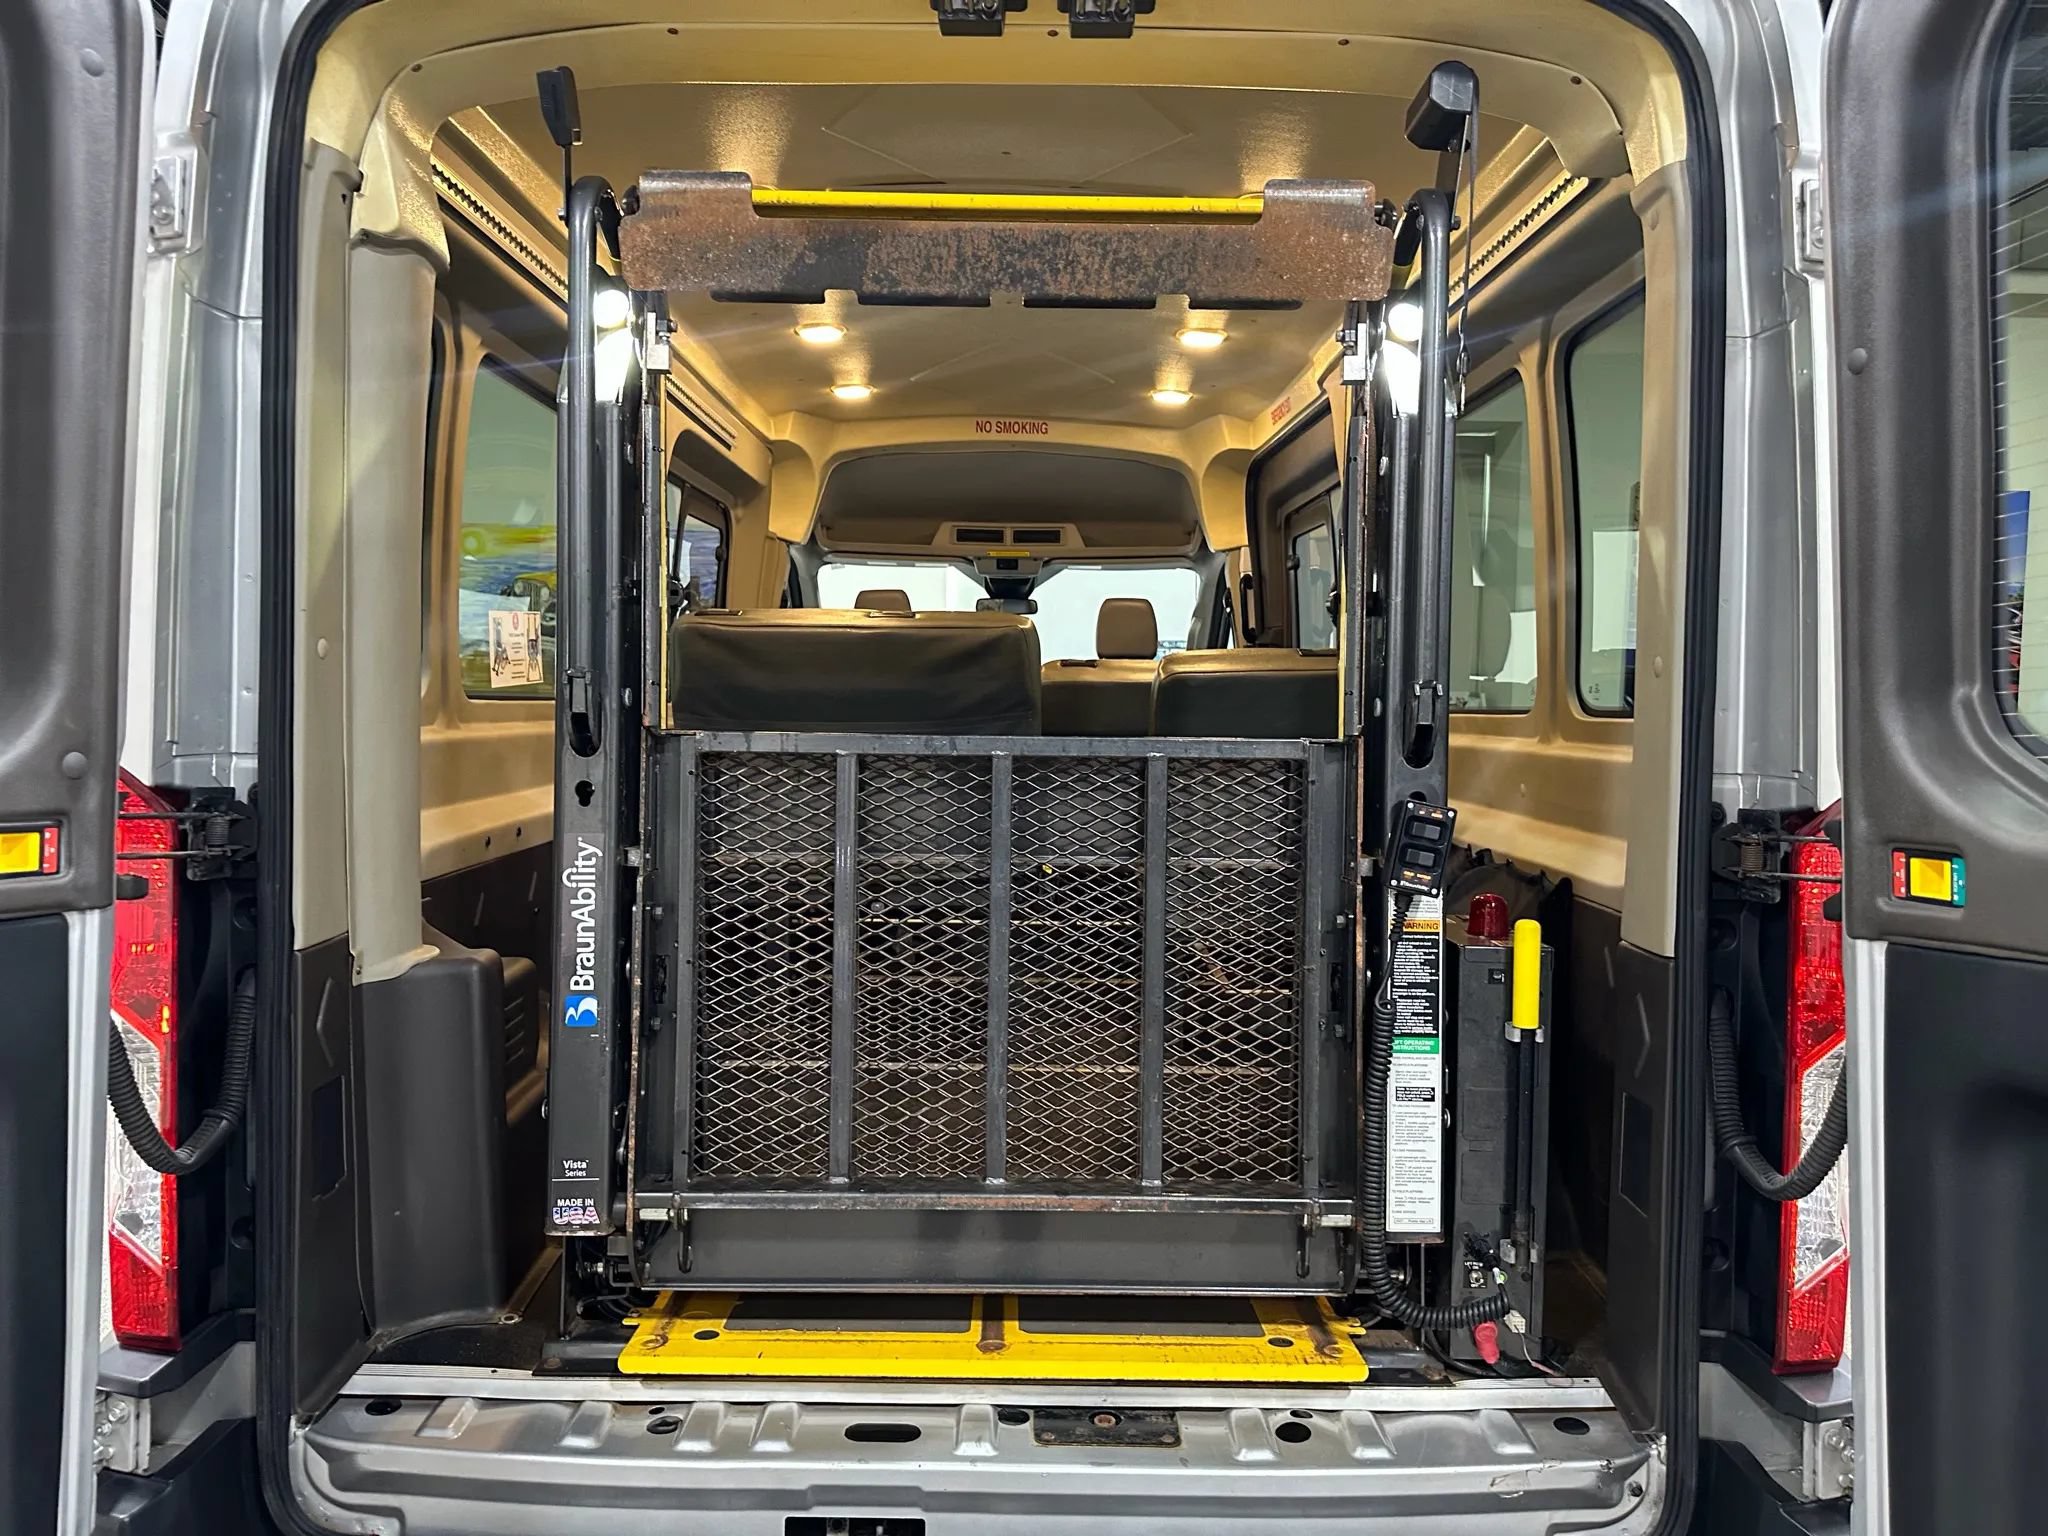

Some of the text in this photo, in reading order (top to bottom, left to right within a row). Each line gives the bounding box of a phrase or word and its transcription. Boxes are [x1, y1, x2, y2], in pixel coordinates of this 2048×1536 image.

[975, 420, 1048, 435] NO SMOKING
[562, 836, 603, 991] BraunAbility
[563, 1160, 588, 1169] Vista
[565, 1169, 587, 1177] Series
[557, 1198, 594, 1206] MADE IN
[552, 1206, 601, 1225] USA
